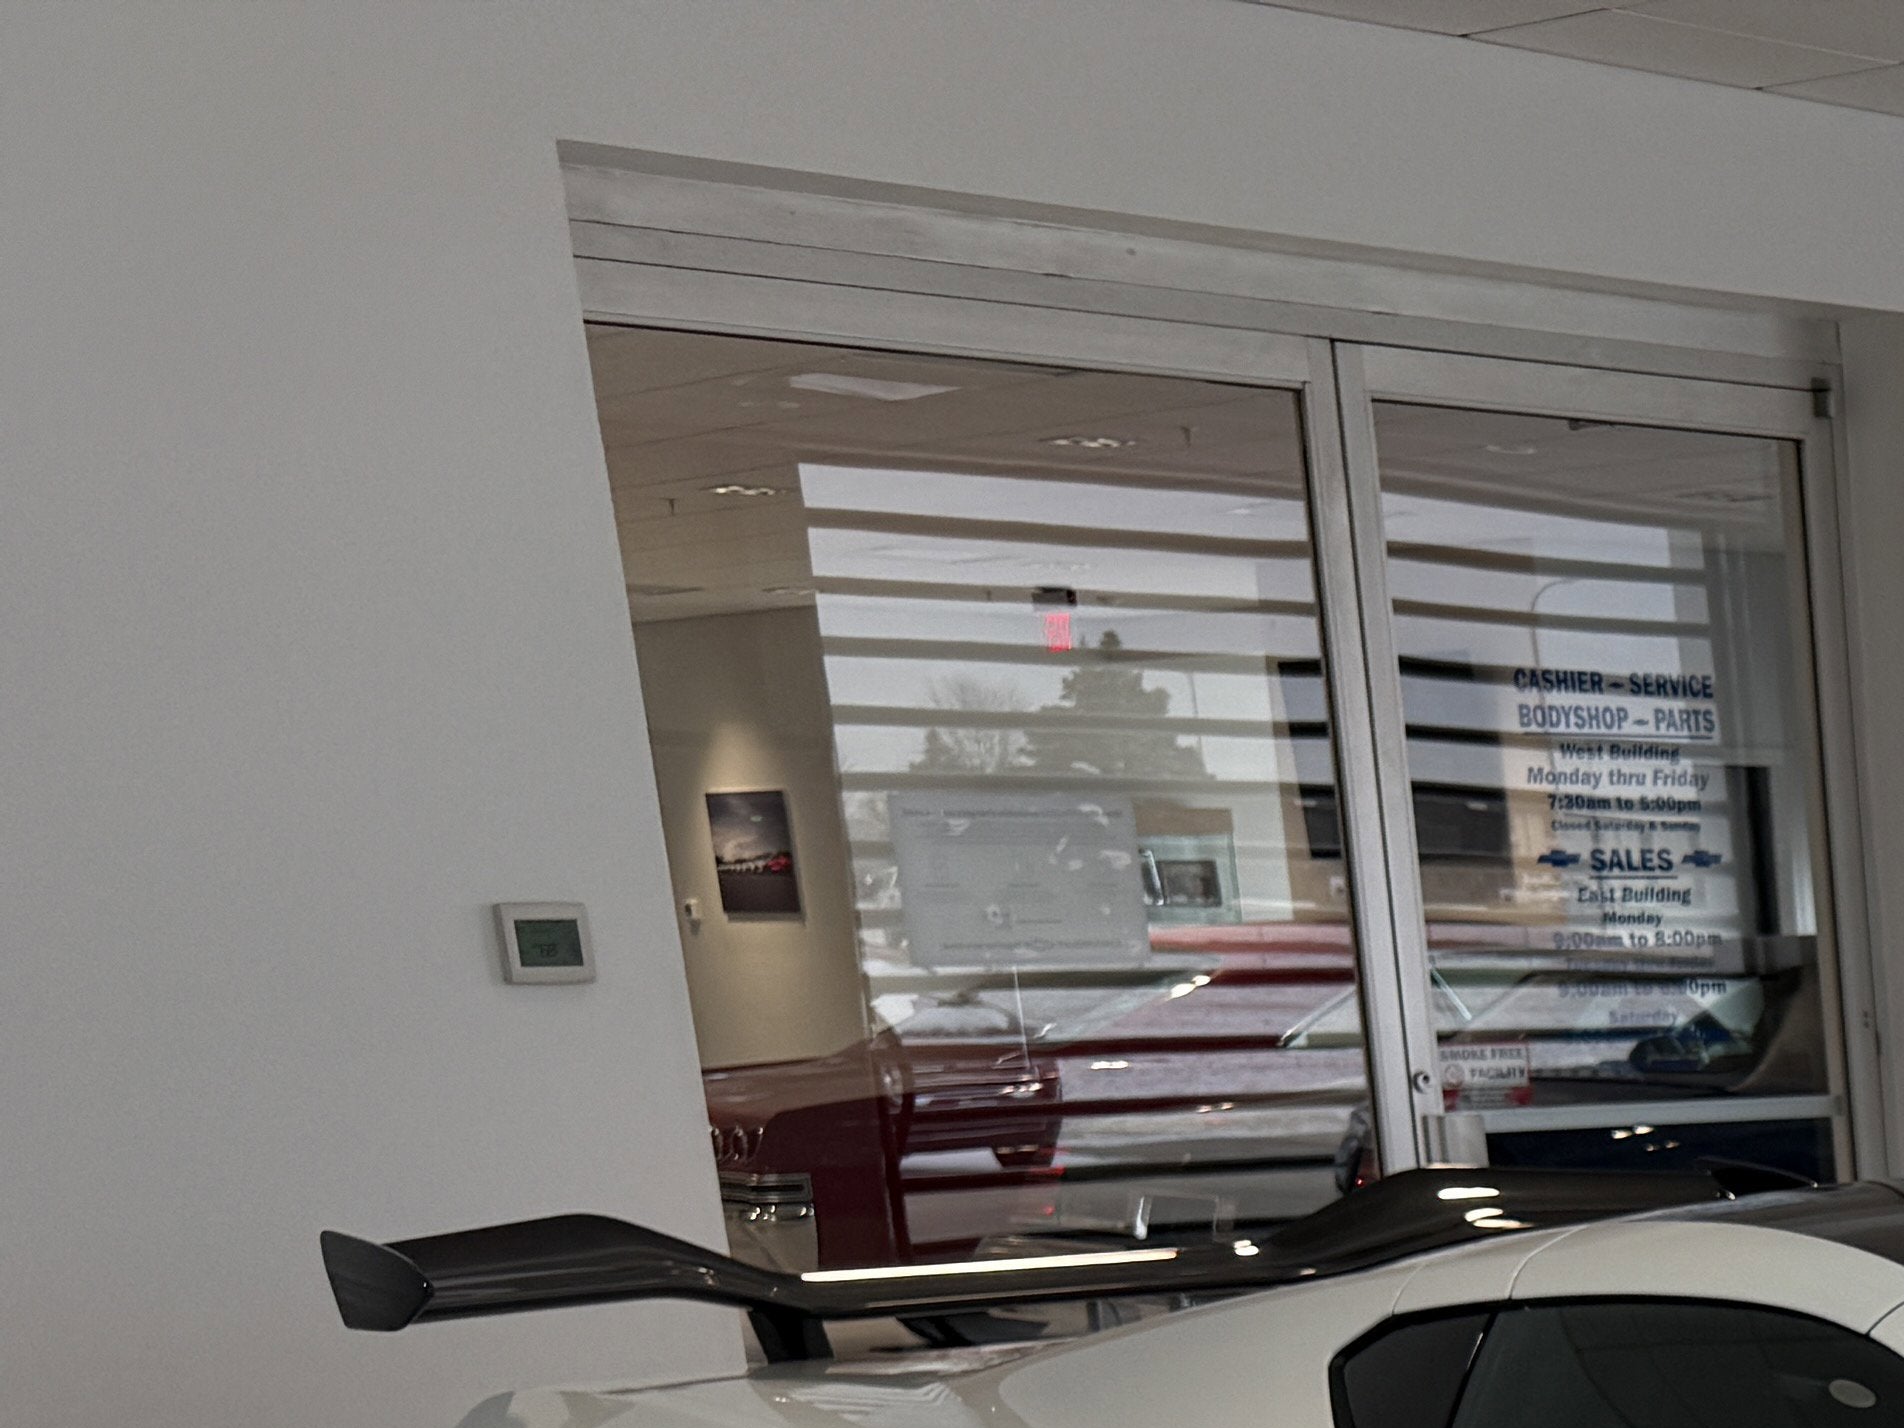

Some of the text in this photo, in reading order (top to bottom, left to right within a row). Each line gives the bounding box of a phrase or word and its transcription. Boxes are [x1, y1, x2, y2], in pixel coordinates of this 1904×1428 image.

[1514, 668, 1714, 698] CASHIER SERVICE
[1518, 703, 1716, 733] BODYSHOP PARTS
[1560, 744, 1681, 764] West Building
[1527, 767, 1709, 791] Monday thru Friday
[1617, 796, 1635, 811] to
[1591, 849, 1674, 872] SALES
[1622, 887, 1692, 906] Building
[1602, 911, 1664, 927] Monday
[1629, 932, 1649, 947] to
